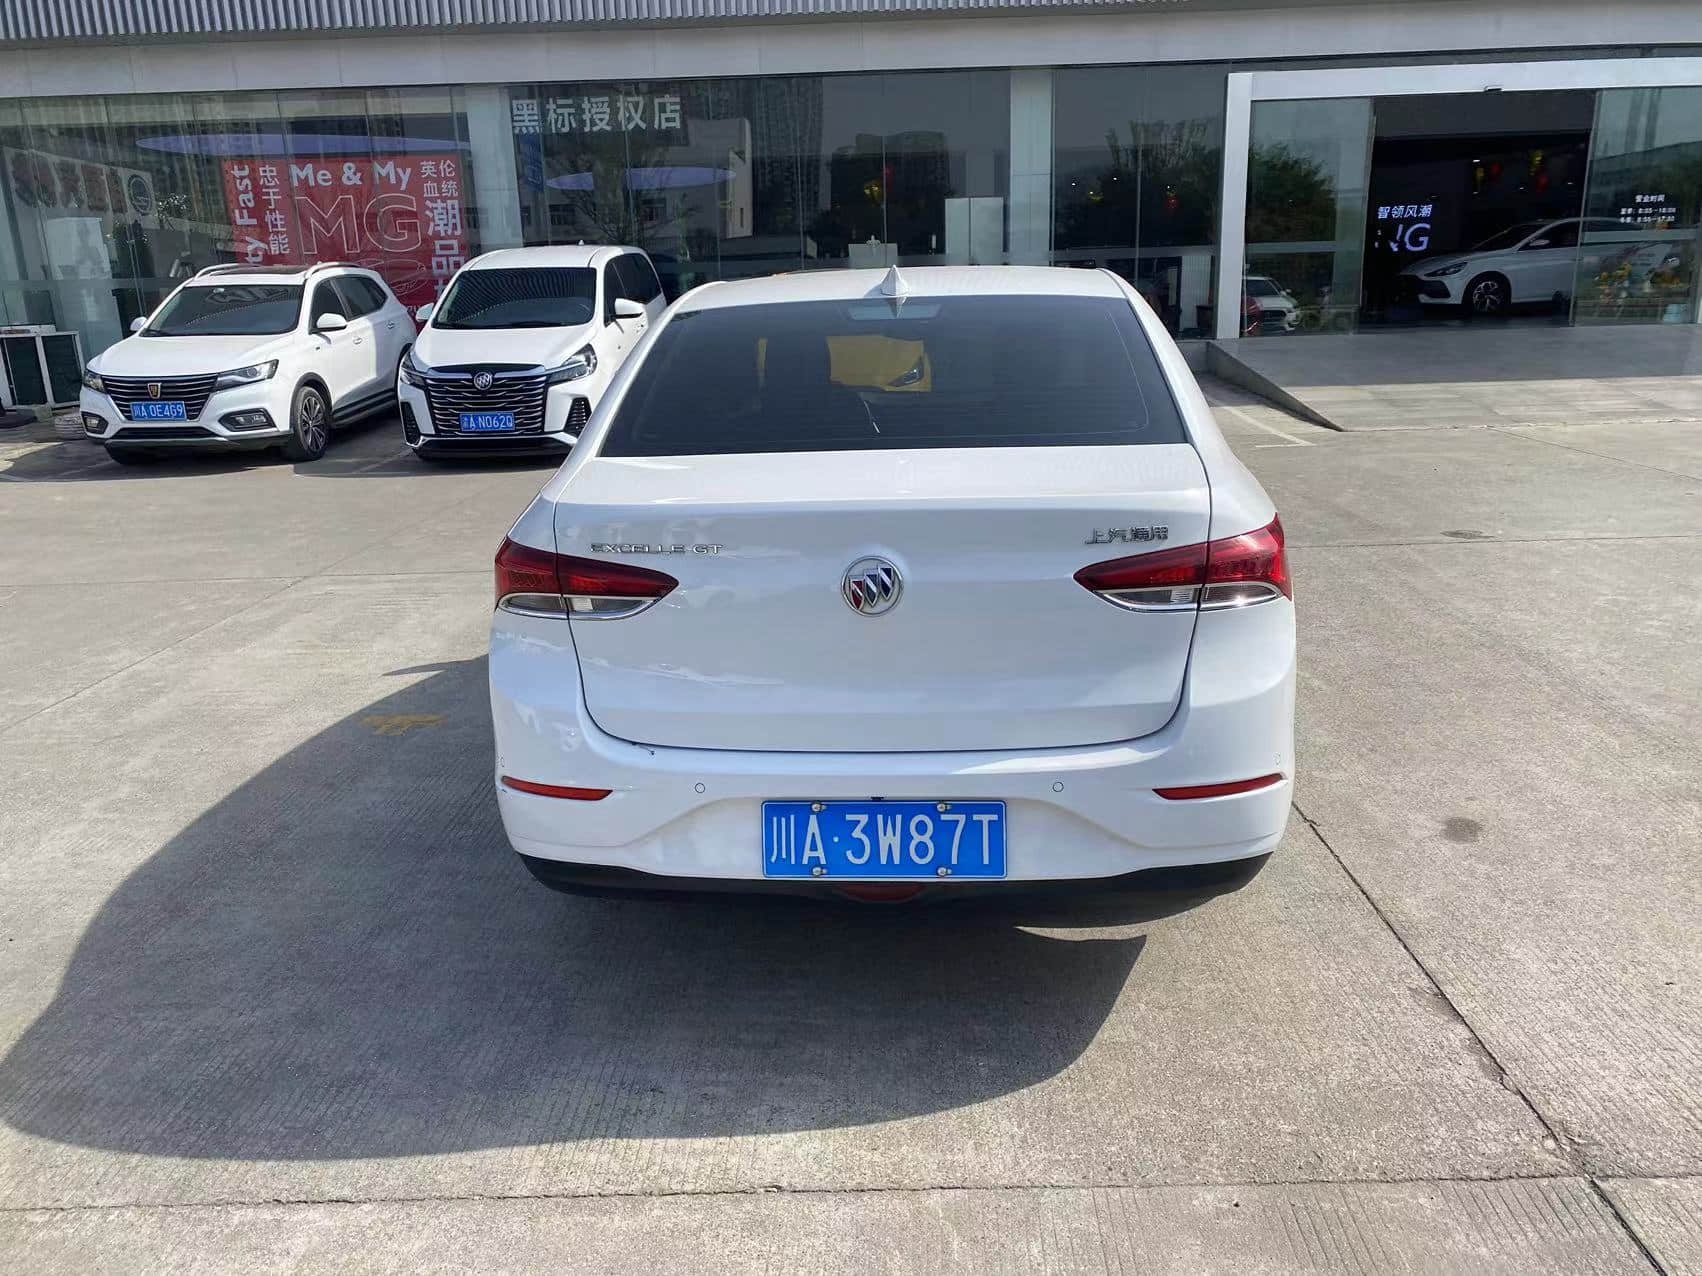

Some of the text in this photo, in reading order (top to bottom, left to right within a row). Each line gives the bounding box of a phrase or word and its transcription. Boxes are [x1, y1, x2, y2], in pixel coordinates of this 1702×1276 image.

[512, 94, 681, 134] 黑标授权店
[290, 161, 412, 190] Me & My
[420, 159, 457, 179] 英伦
[231, 164, 258, 226] Fast
[423, 180, 459, 198] 血统
[258, 164, 291, 256] 忠于性能
[295, 193, 422, 255] MG
[590, 543, 723, 554] EXCELLE GT
